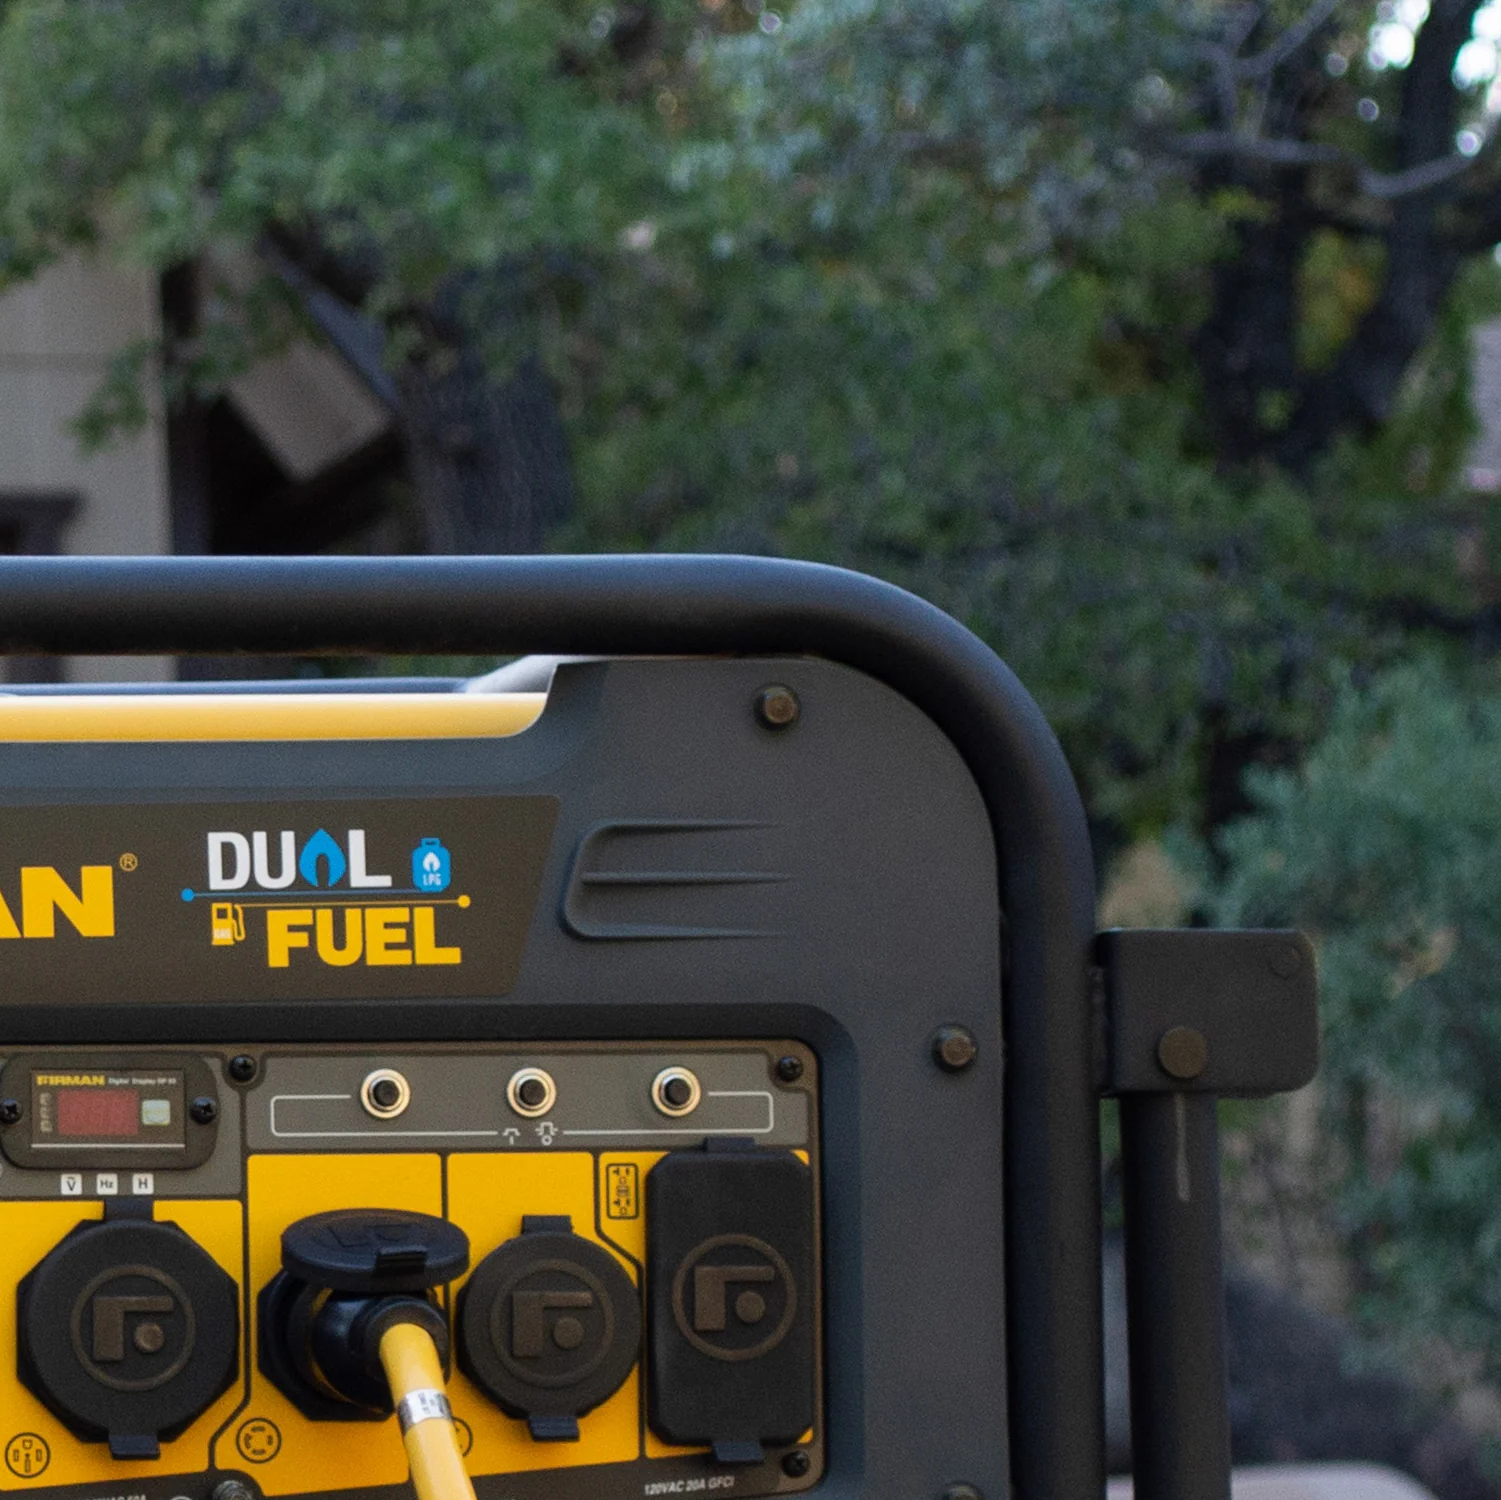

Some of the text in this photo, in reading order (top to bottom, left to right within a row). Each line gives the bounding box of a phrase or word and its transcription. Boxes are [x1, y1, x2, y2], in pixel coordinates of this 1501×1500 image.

[423, 874, 441, 887] LPG
[266, 906, 462, 968] FUEL
[36, 1075, 105, 1086] FIRMAN
[100, 1178, 114, 1189] Hz
[138, 1178, 148, 1189] H
[644, 1475, 735, 1496] 120VAC 20A GFCI
